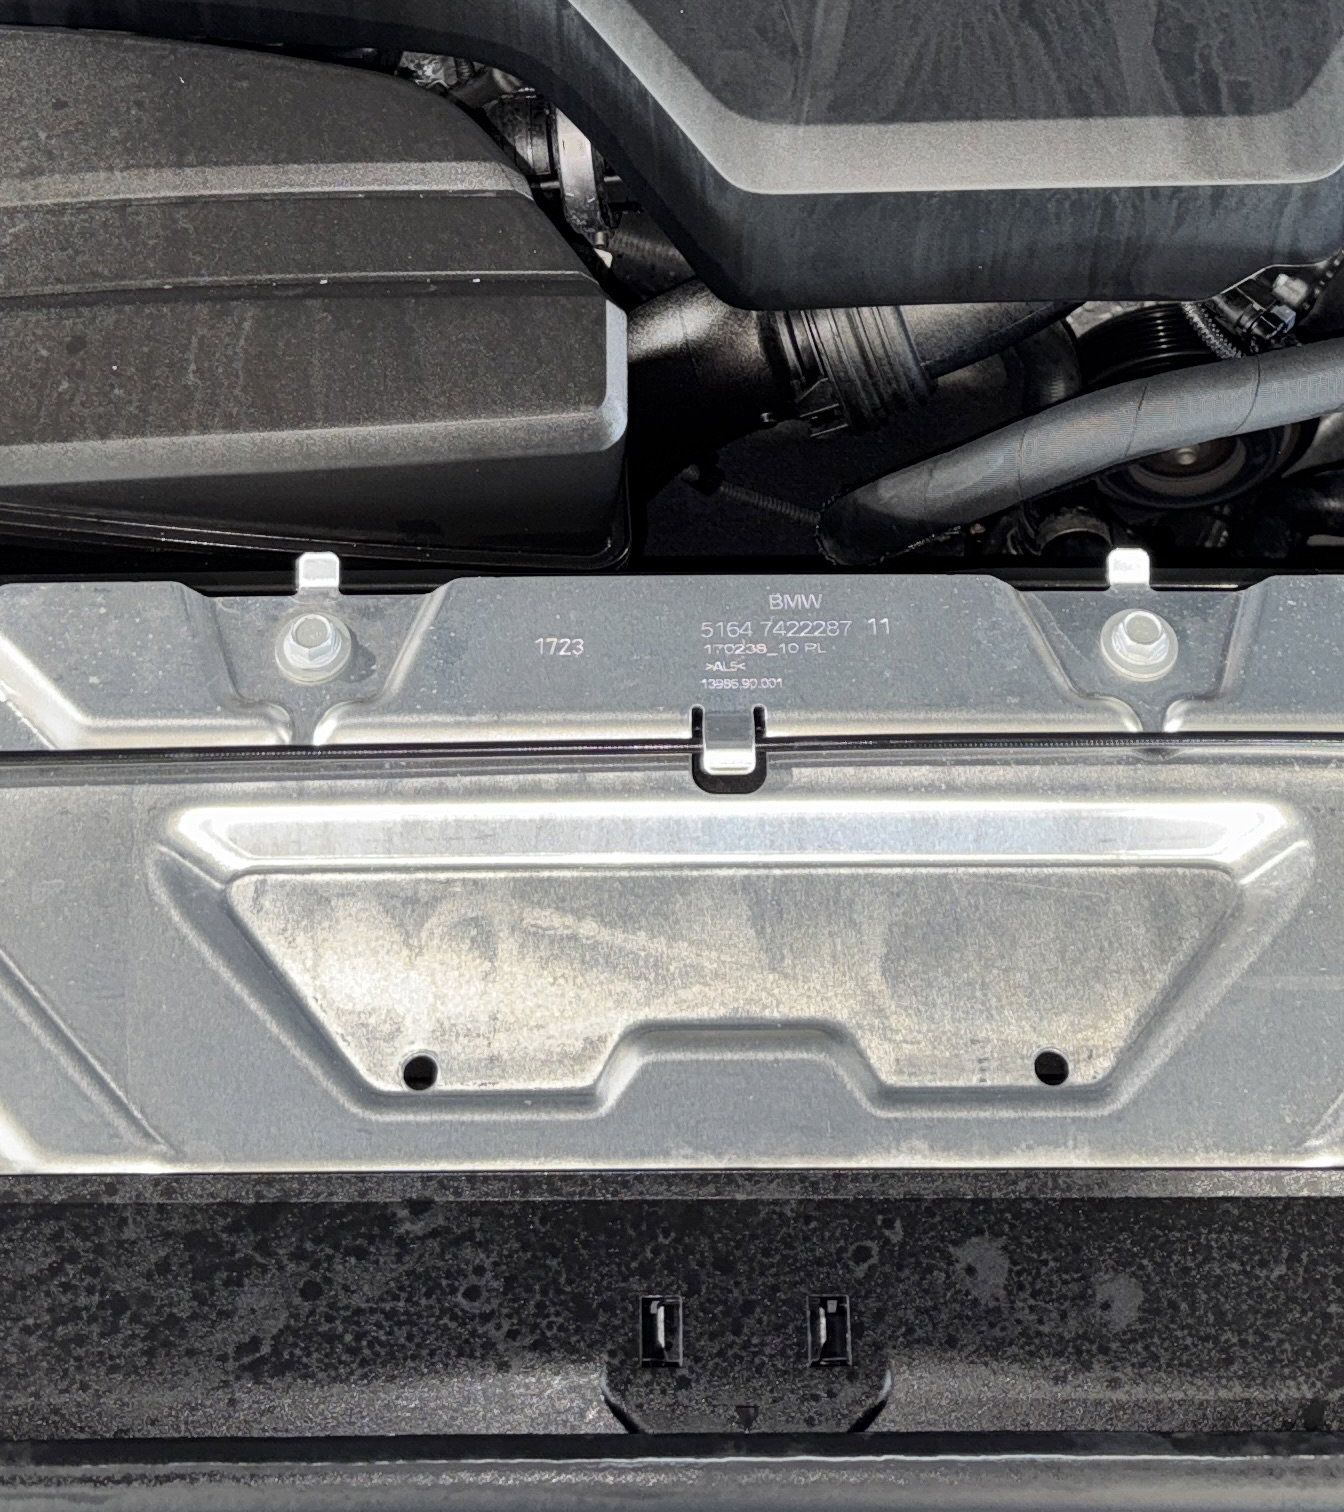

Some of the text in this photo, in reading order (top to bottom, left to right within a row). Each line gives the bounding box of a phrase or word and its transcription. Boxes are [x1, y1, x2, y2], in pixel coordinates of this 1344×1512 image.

[769, 594, 822, 610] BMW
[701, 618, 890, 637] 5164 7422287 11
[534, 638, 584, 656] 1723
